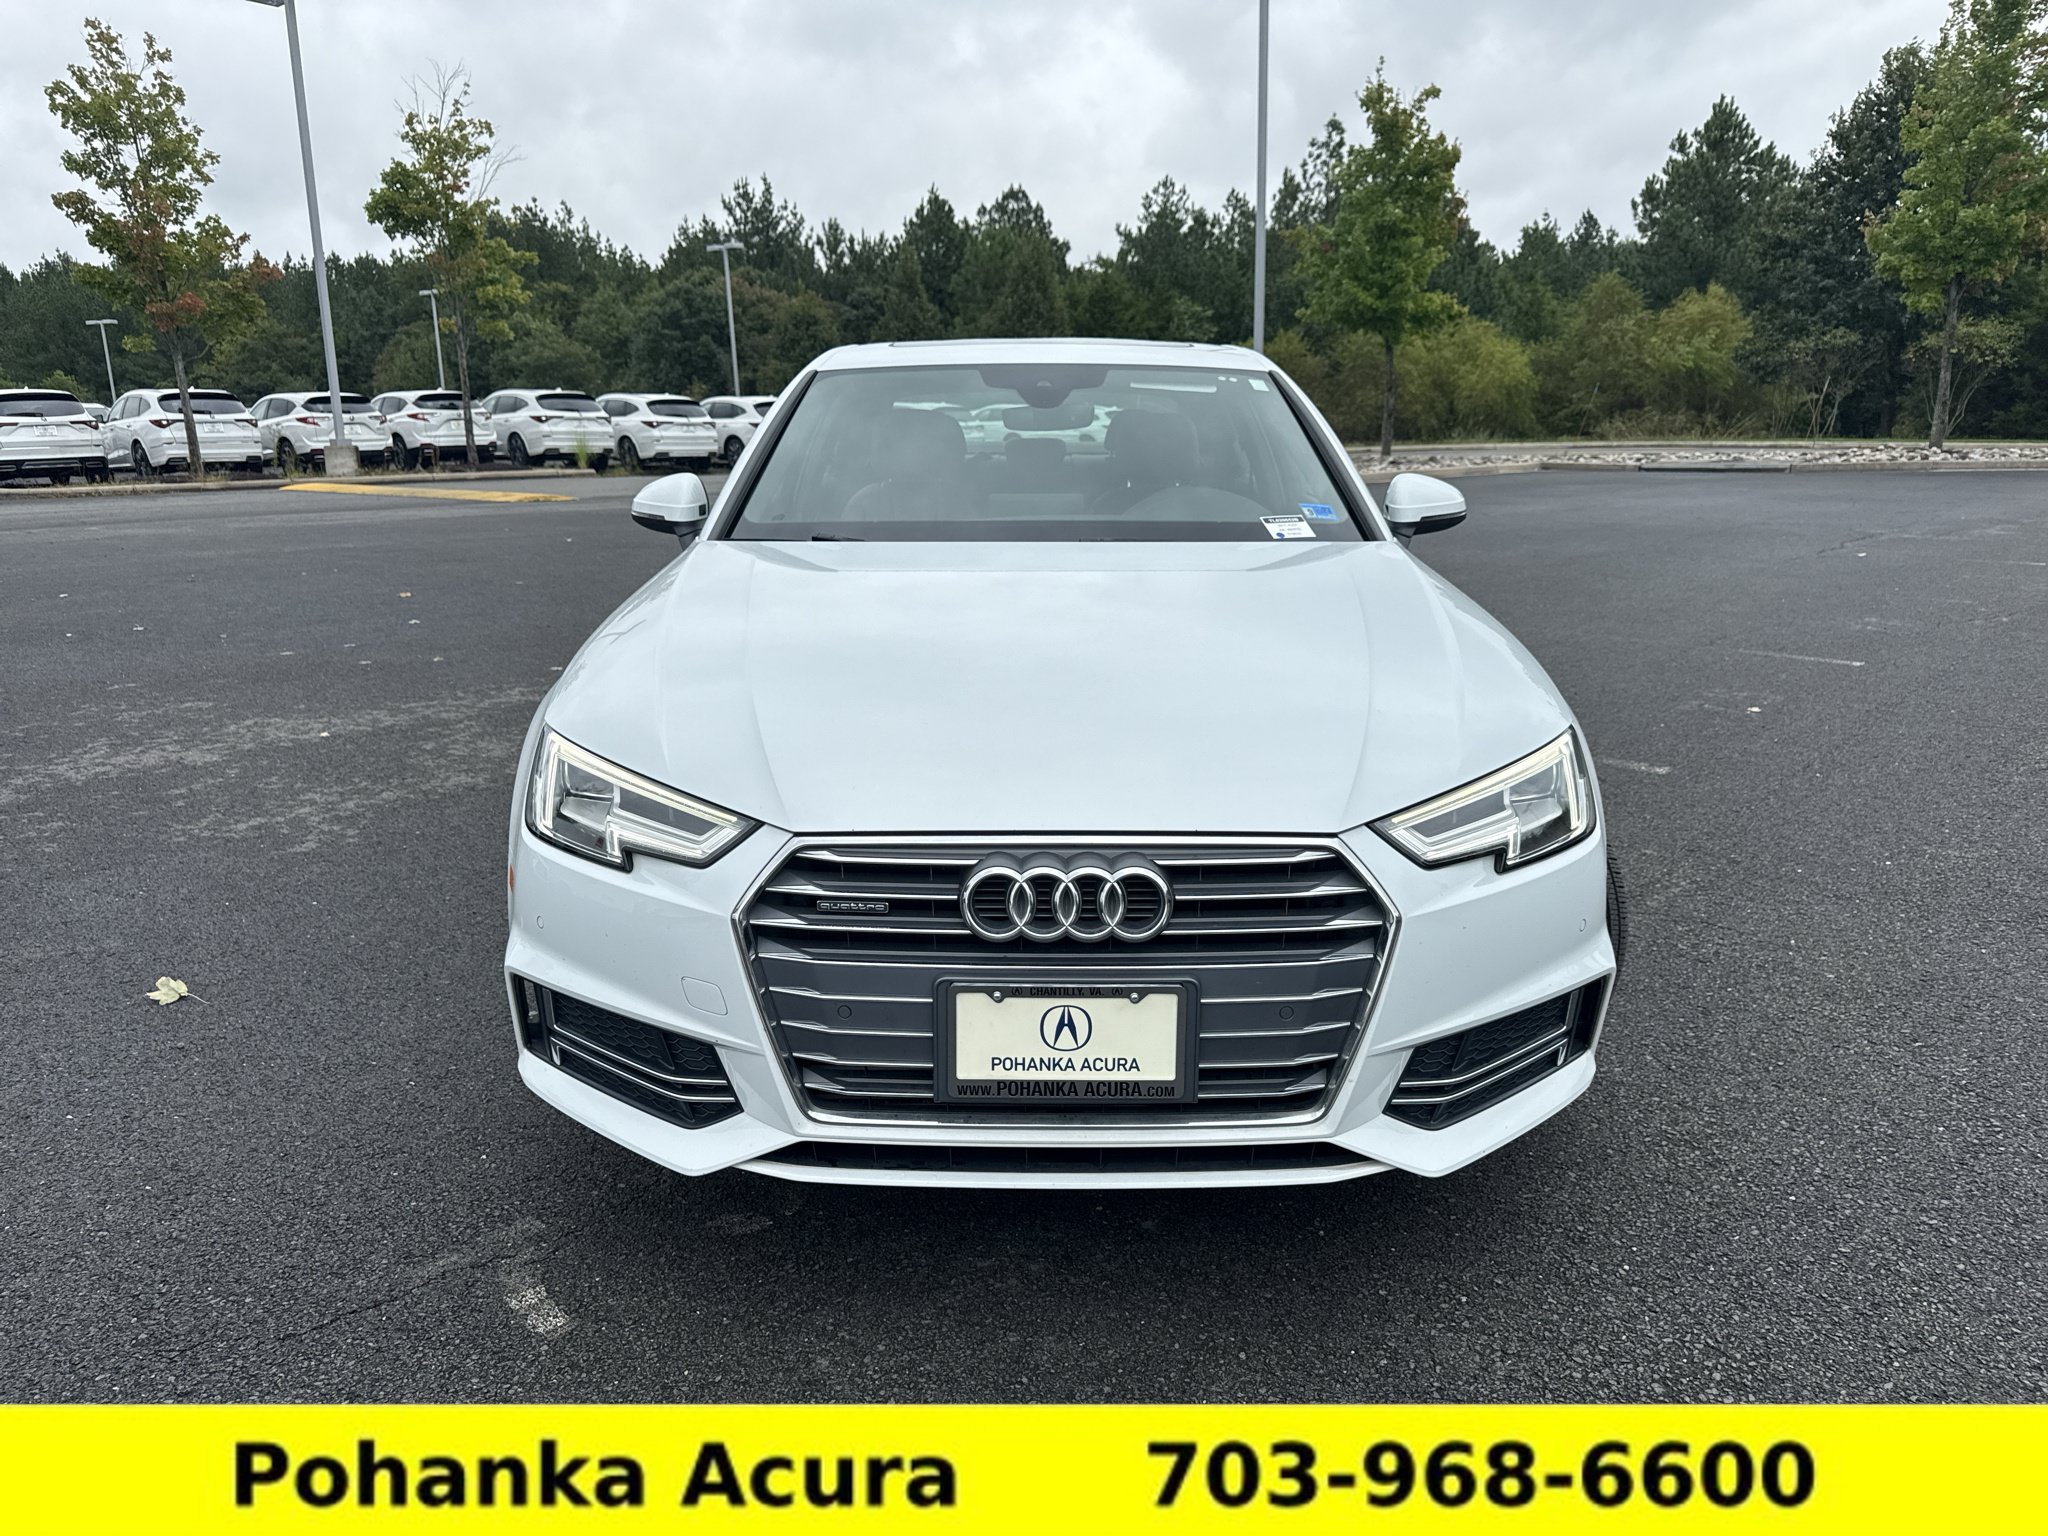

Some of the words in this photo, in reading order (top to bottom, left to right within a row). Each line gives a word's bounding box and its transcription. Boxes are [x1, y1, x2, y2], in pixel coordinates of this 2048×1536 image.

[819, 902, 886, 912] quattro
[1088, 986, 1105, 997] VA.
[991, 1056, 1076, 1072] POHANKA
[1079, 1056, 1141, 1072] ACURA
